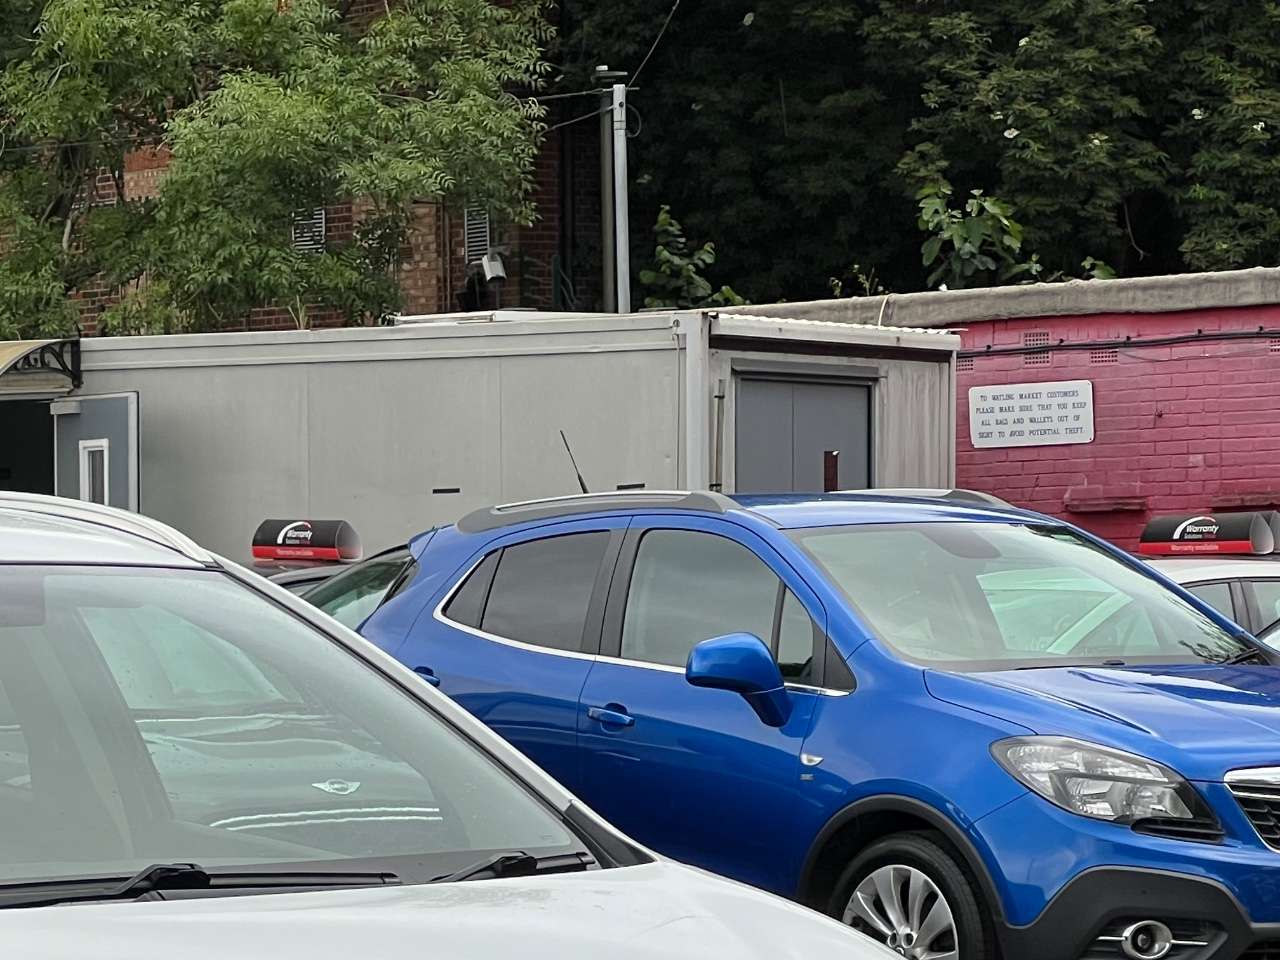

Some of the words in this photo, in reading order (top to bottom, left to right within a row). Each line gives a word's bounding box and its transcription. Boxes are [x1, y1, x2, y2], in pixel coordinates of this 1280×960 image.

[1047, 390, 1079, 398] CUSTOMERS
[976, 406, 995, 414] PLEASE
[999, 405, 1015, 413] MAKE
[1037, 403, 1052, 411] THAT
[1057, 402, 1068, 410] YOU
[1029, 428, 1060, 436] POTENTIAL
[1186, 525, 1219, 534] Warranty
